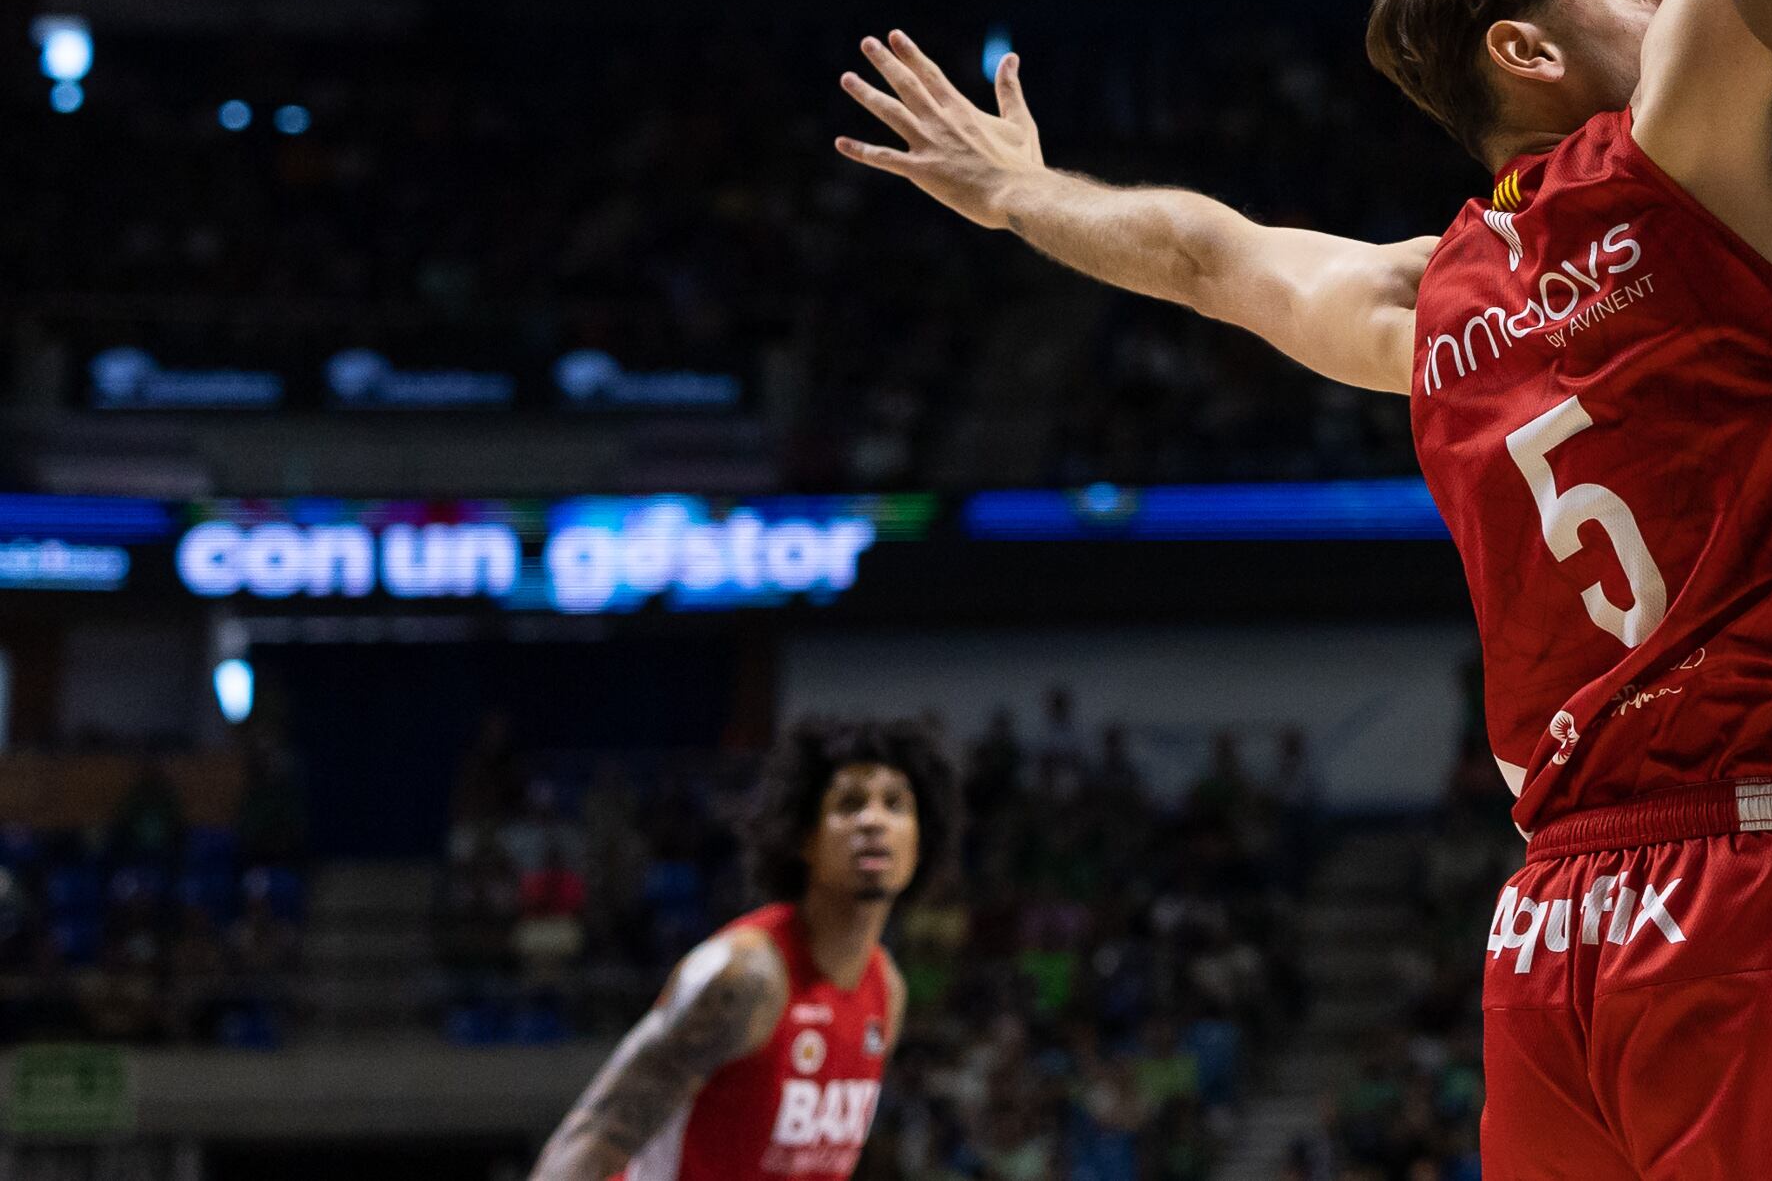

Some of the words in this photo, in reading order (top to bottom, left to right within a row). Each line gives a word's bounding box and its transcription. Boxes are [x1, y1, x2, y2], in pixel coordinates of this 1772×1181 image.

[1545, 329, 1567, 348] by
[1570, 273, 1654, 337] AVINENT
[178, 521, 374, 598] con
[380, 521, 520, 598] un
[1505, 394, 1667, 648] 5
